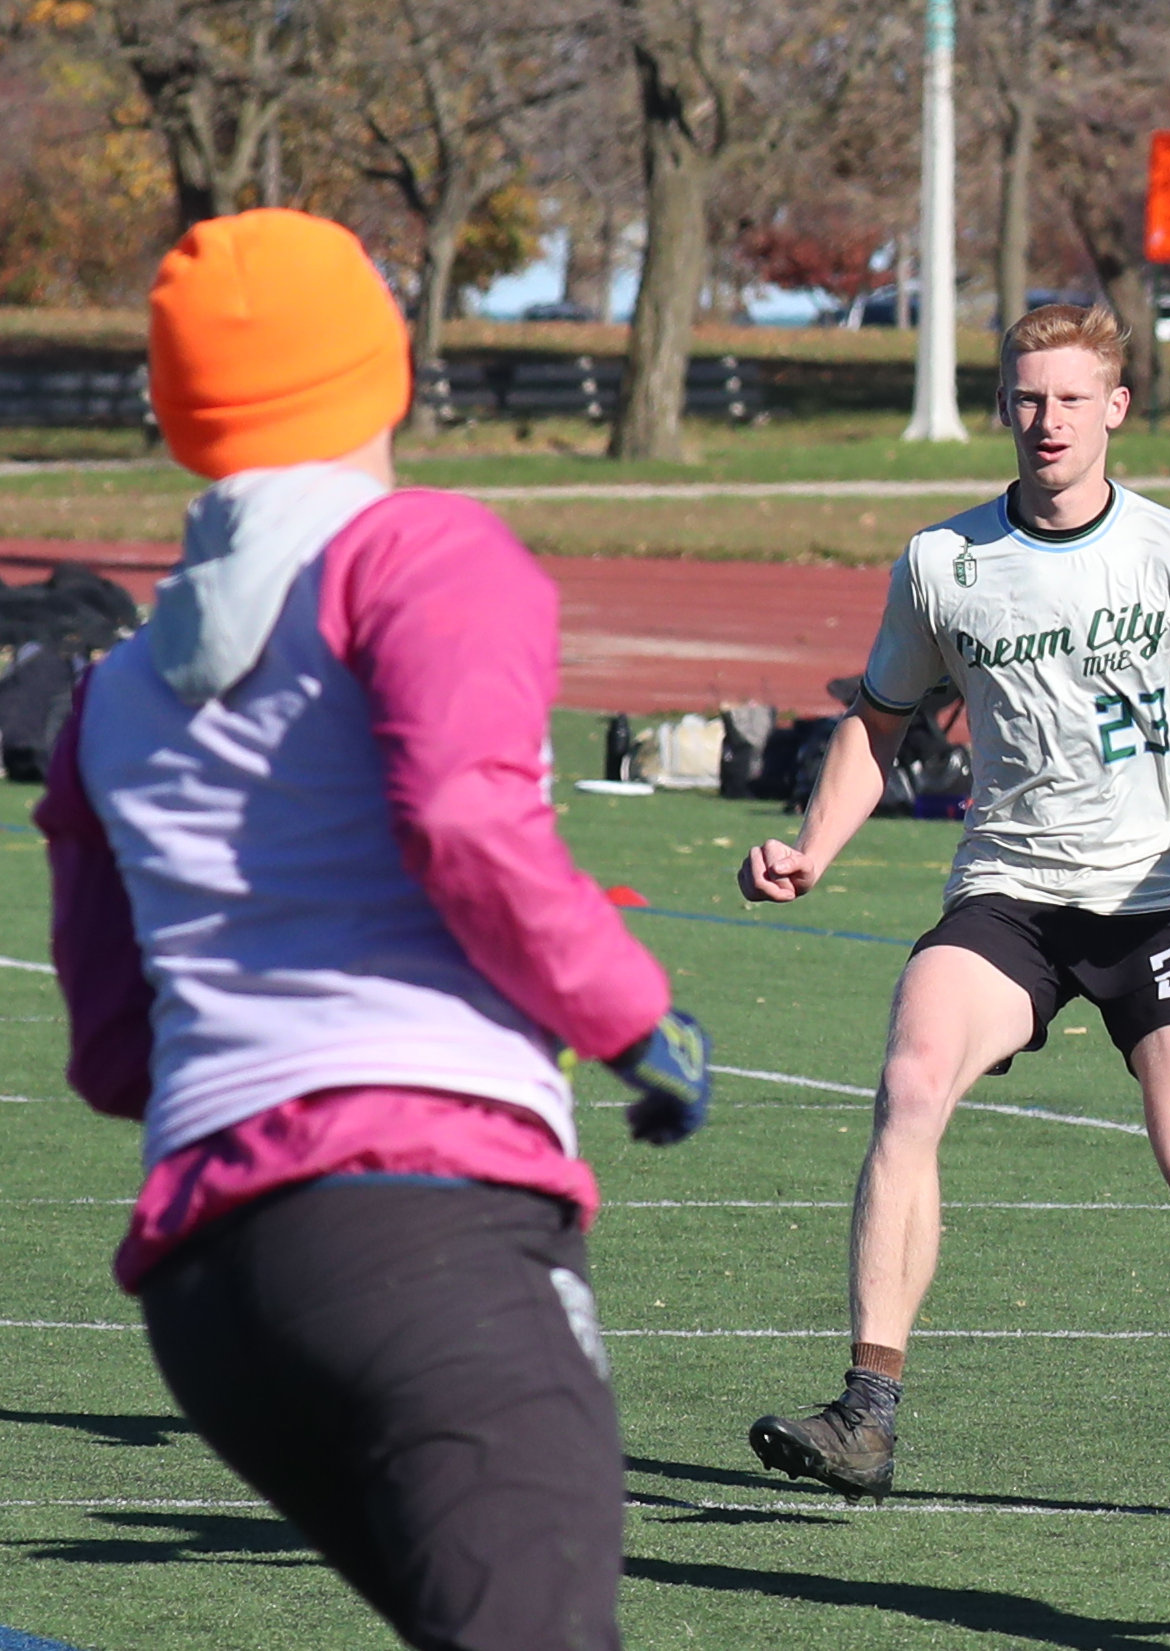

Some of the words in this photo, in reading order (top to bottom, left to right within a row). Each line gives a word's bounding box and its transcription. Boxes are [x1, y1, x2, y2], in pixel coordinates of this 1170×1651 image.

[956, 626, 1075, 668] Cream
[1087, 602, 1168, 660] City
[1083, 650, 1133, 677] MKE
[1094, 687, 1170, 765] 23
